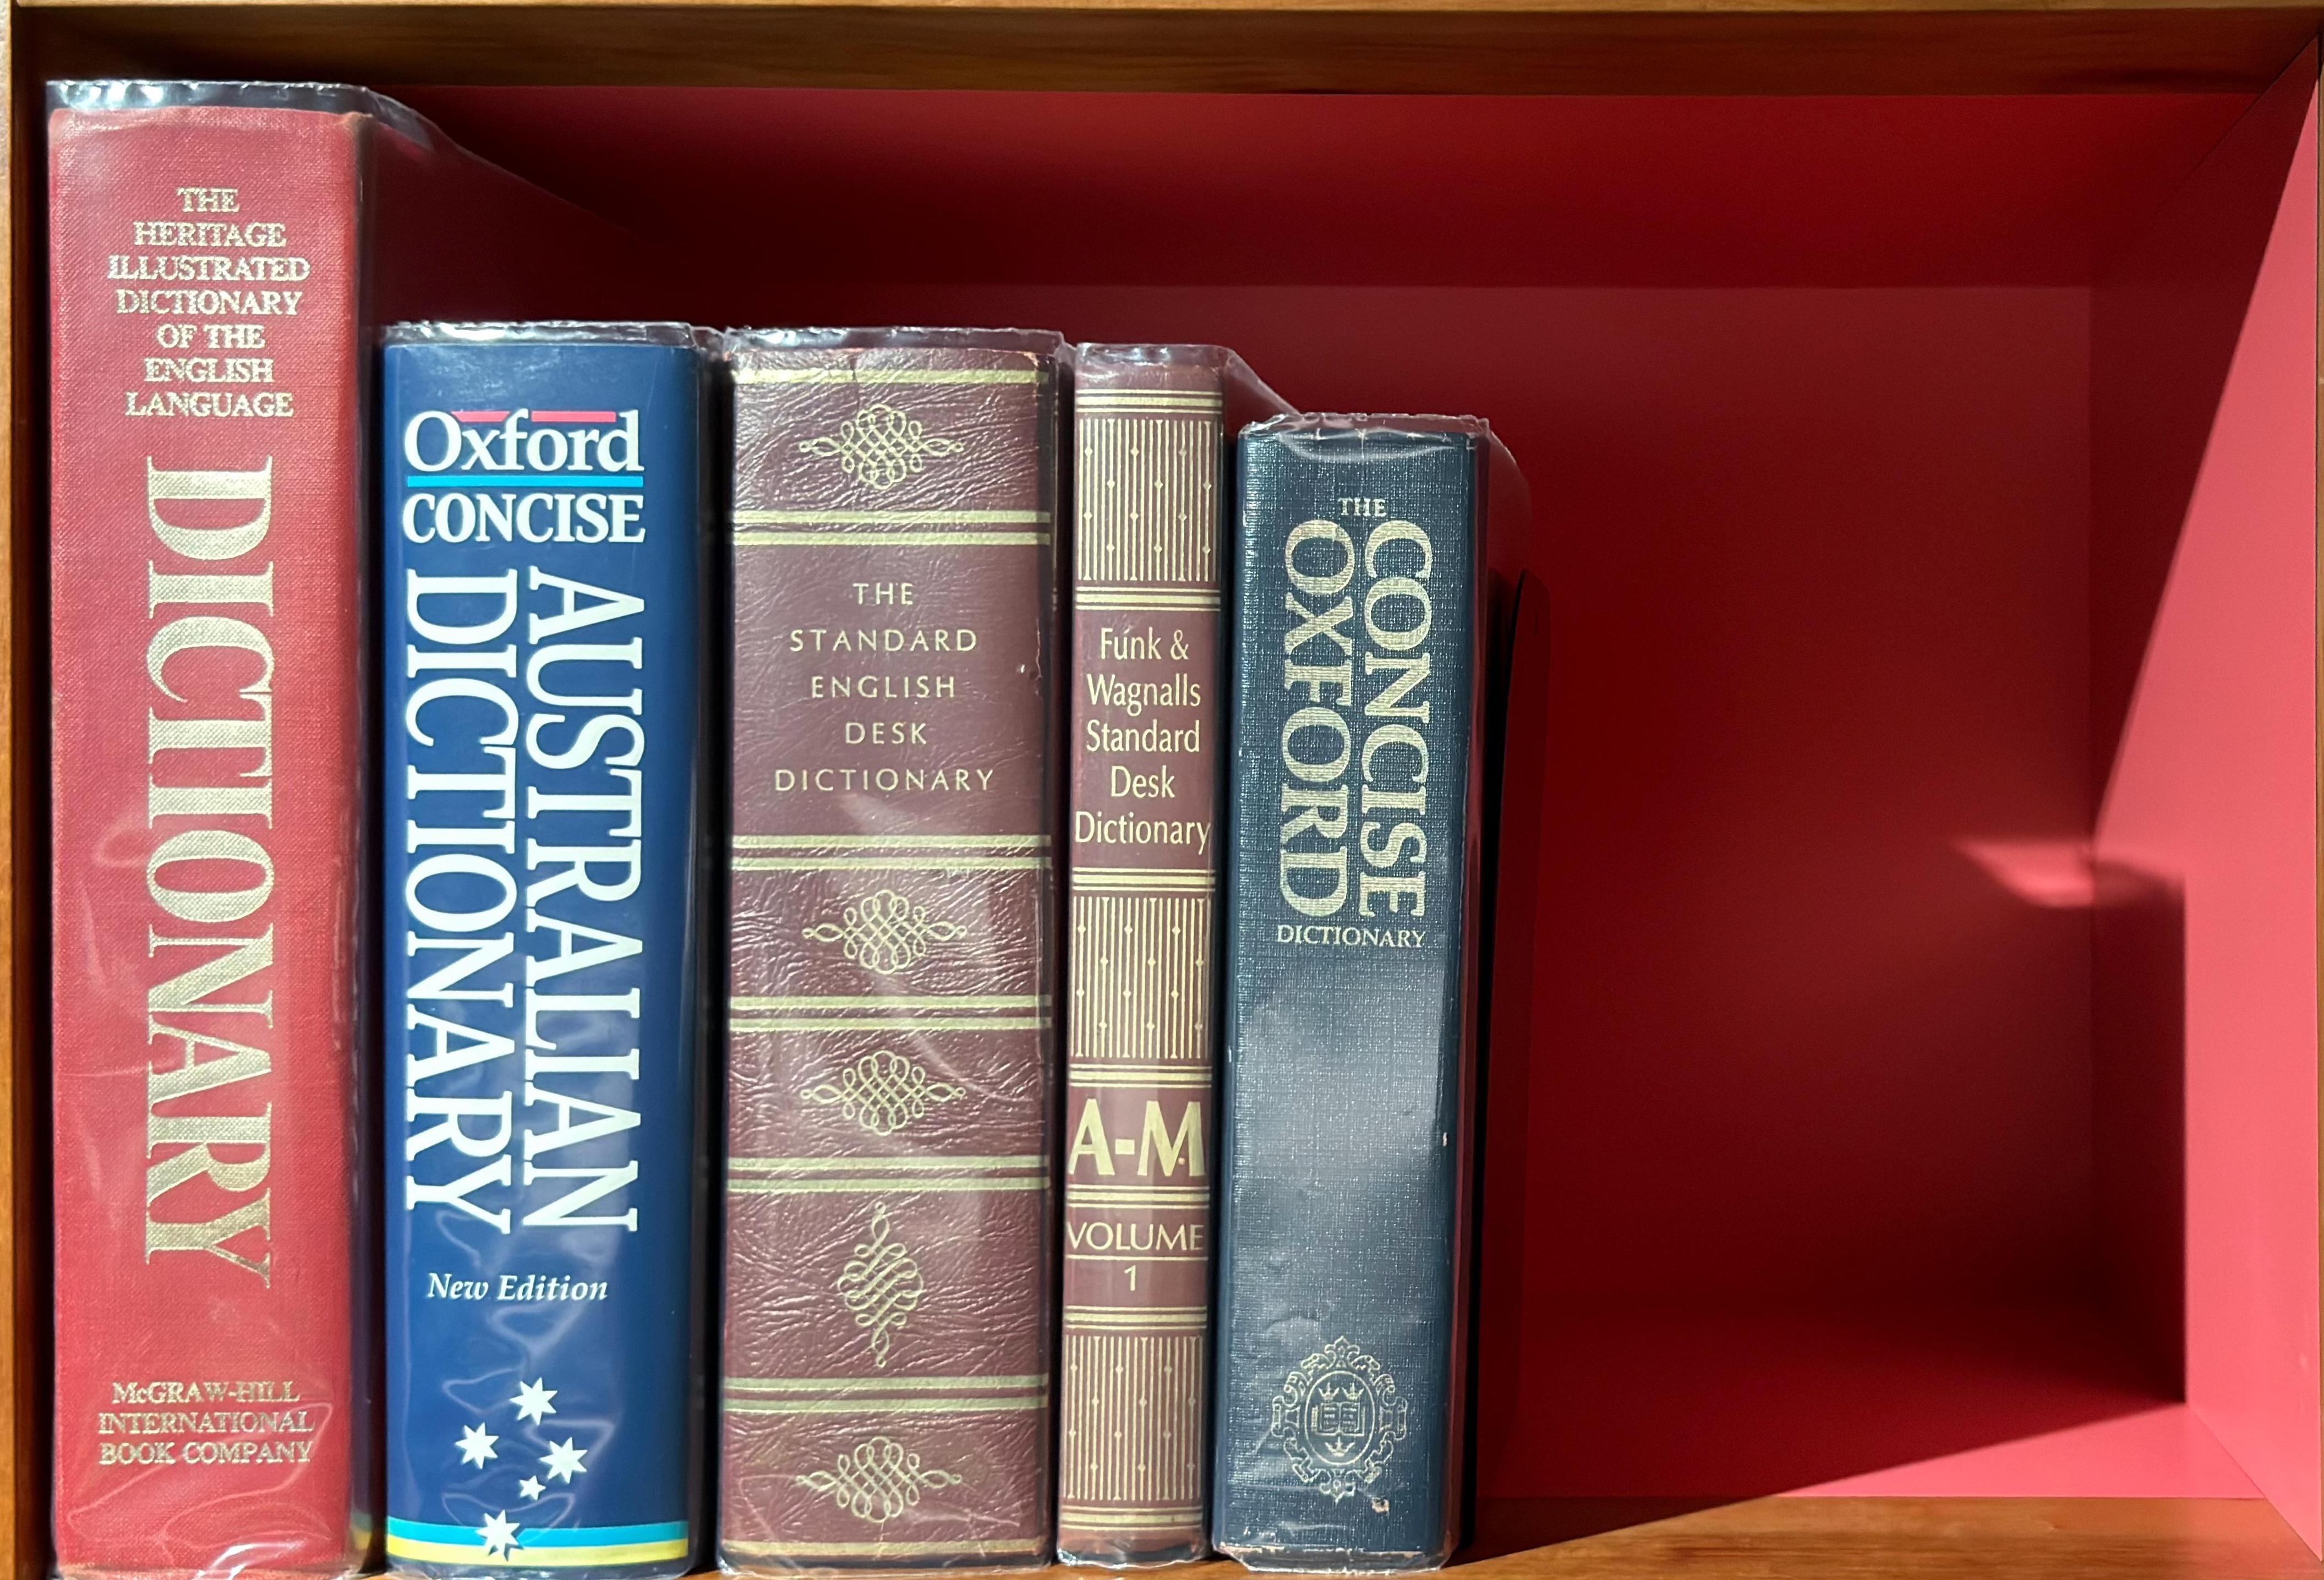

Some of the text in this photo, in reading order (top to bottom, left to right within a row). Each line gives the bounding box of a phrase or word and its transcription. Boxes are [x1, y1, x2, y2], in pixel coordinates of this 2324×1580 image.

[177, 187, 240, 212] THE
[133, 221, 287, 247] HERITAGE
[107, 255, 311, 281] ILLUSTRATED
[116, 289, 303, 315] DICTIONARY
[157, 324, 266, 349] OF THE
[144, 357, 275, 383] ENGLISH
[125, 392, 294, 418] LANGUAGE
[404, 408, 644, 472] Oxford
[402, 493, 646, 543] CONCISE
[1338, 497, 1387, 517] THE
[852, 583, 914, 605] THE
[790, 629, 977, 653] STANDARD
[1101, 626, 1189, 660] Funk &
[812, 675, 955, 698] ENGLISH
[1086, 674, 1201, 717] Wagnalls
[1279, 519, 1355, 917] OXFORD
[1359, 520, 1433, 917] CONCISE
[846, 723, 927, 745] DESK
[1086, 719, 1200, 752] Standard
[775, 769, 994, 792] DICTIONARY
[1111, 765, 1175, 798] Desk
[1075, 811, 1211, 855] Dictionary
[145, 456, 276, 1288] DICTIONARY
[405, 568, 520, 1234] DICTIONARY
[526, 565, 645, 1233] AUSTRALIAN
[1277, 925, 1426, 949] DICTIONARY
[1068, 1098, 1206, 1177] A-M
[1067, 1222, 1205, 1250] VOLUME
[427, 1272, 608, 1301] New Edition
[1124, 1265, 1136, 1291] 1
[112, 1381, 299, 1403] McGRAW-HILL
[98, 1411, 315, 1434] INTERNATIONAL
[99, 1441, 313, 1465] BOOK COMPANY
